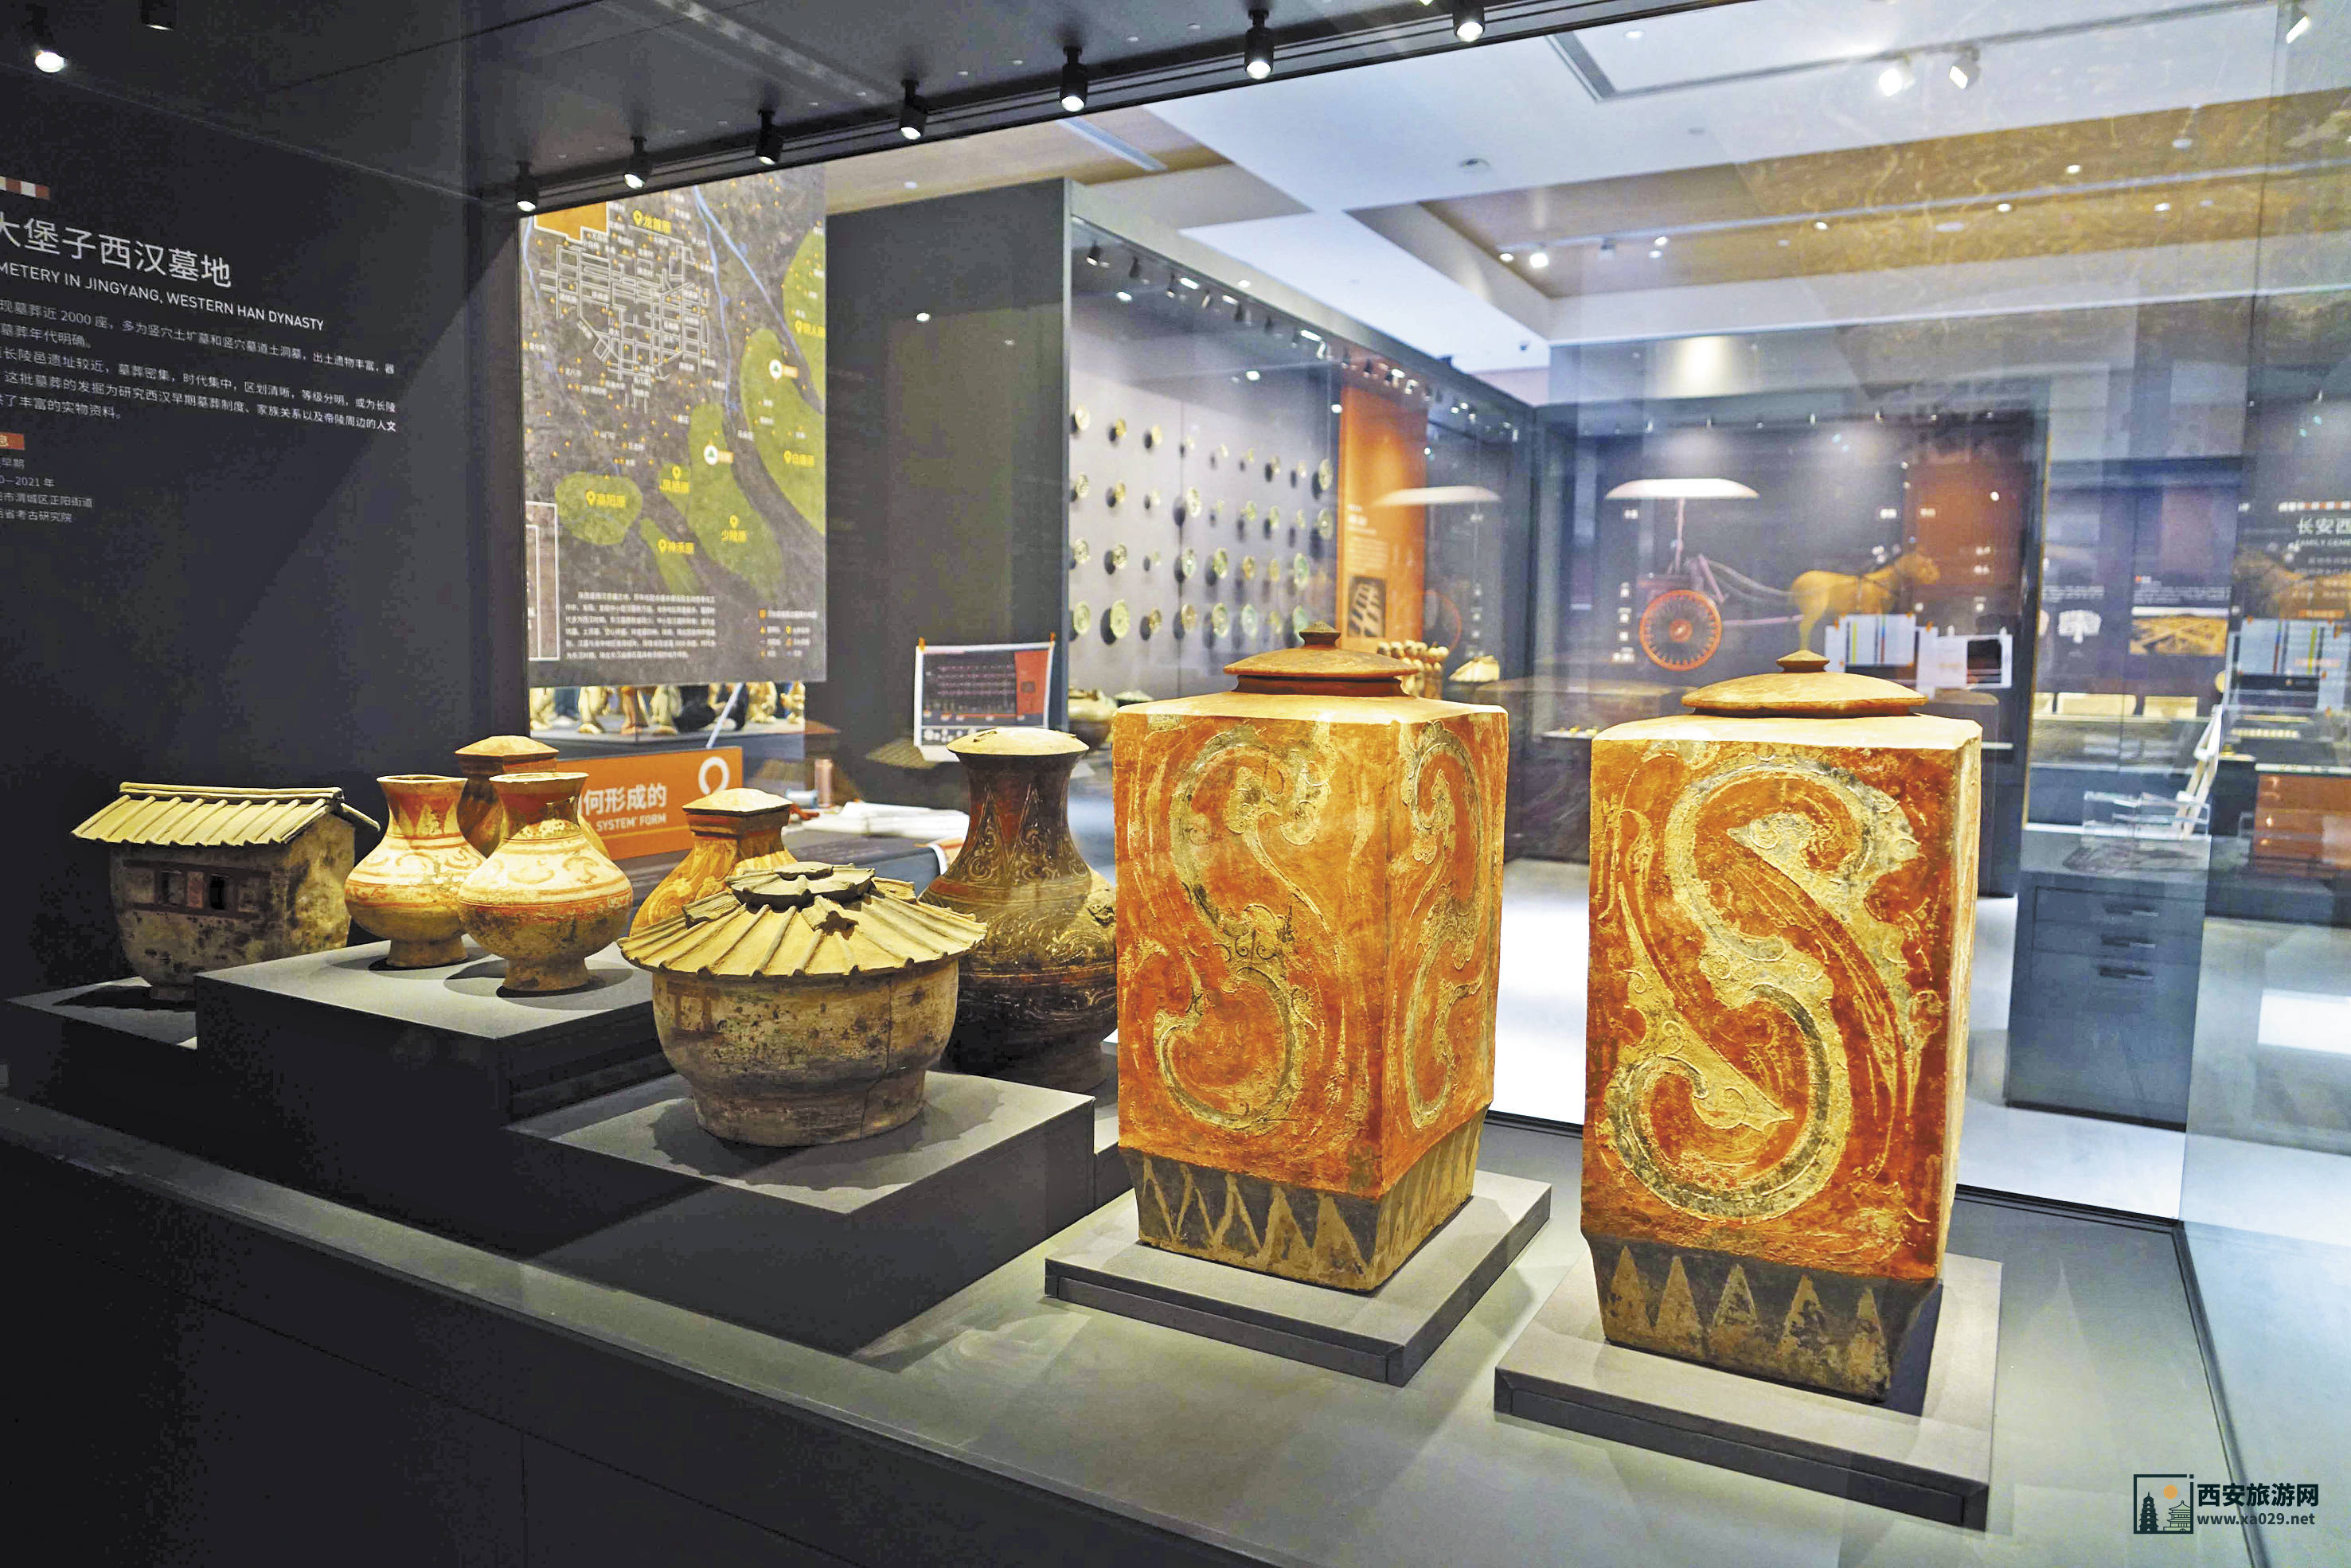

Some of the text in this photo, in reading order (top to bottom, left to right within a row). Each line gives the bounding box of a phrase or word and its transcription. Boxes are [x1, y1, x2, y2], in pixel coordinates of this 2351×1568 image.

[0, 211, 232, 288] 大堡子西汉墓地
[64, 273, 80, 287] IN
[85, 277, 163, 305] JINGYANG,
[166, 291, 233, 315] WESTERN
[237, 305, 265, 321] HAN
[269, 310, 324, 331] DYNASTY
[61, 310, 92, 326] 2000
[0, 394, 120, 419] 了丰富的实物资料。
[578, 782, 668, 816] 何形成的
[639, 812, 667, 827] FORM
